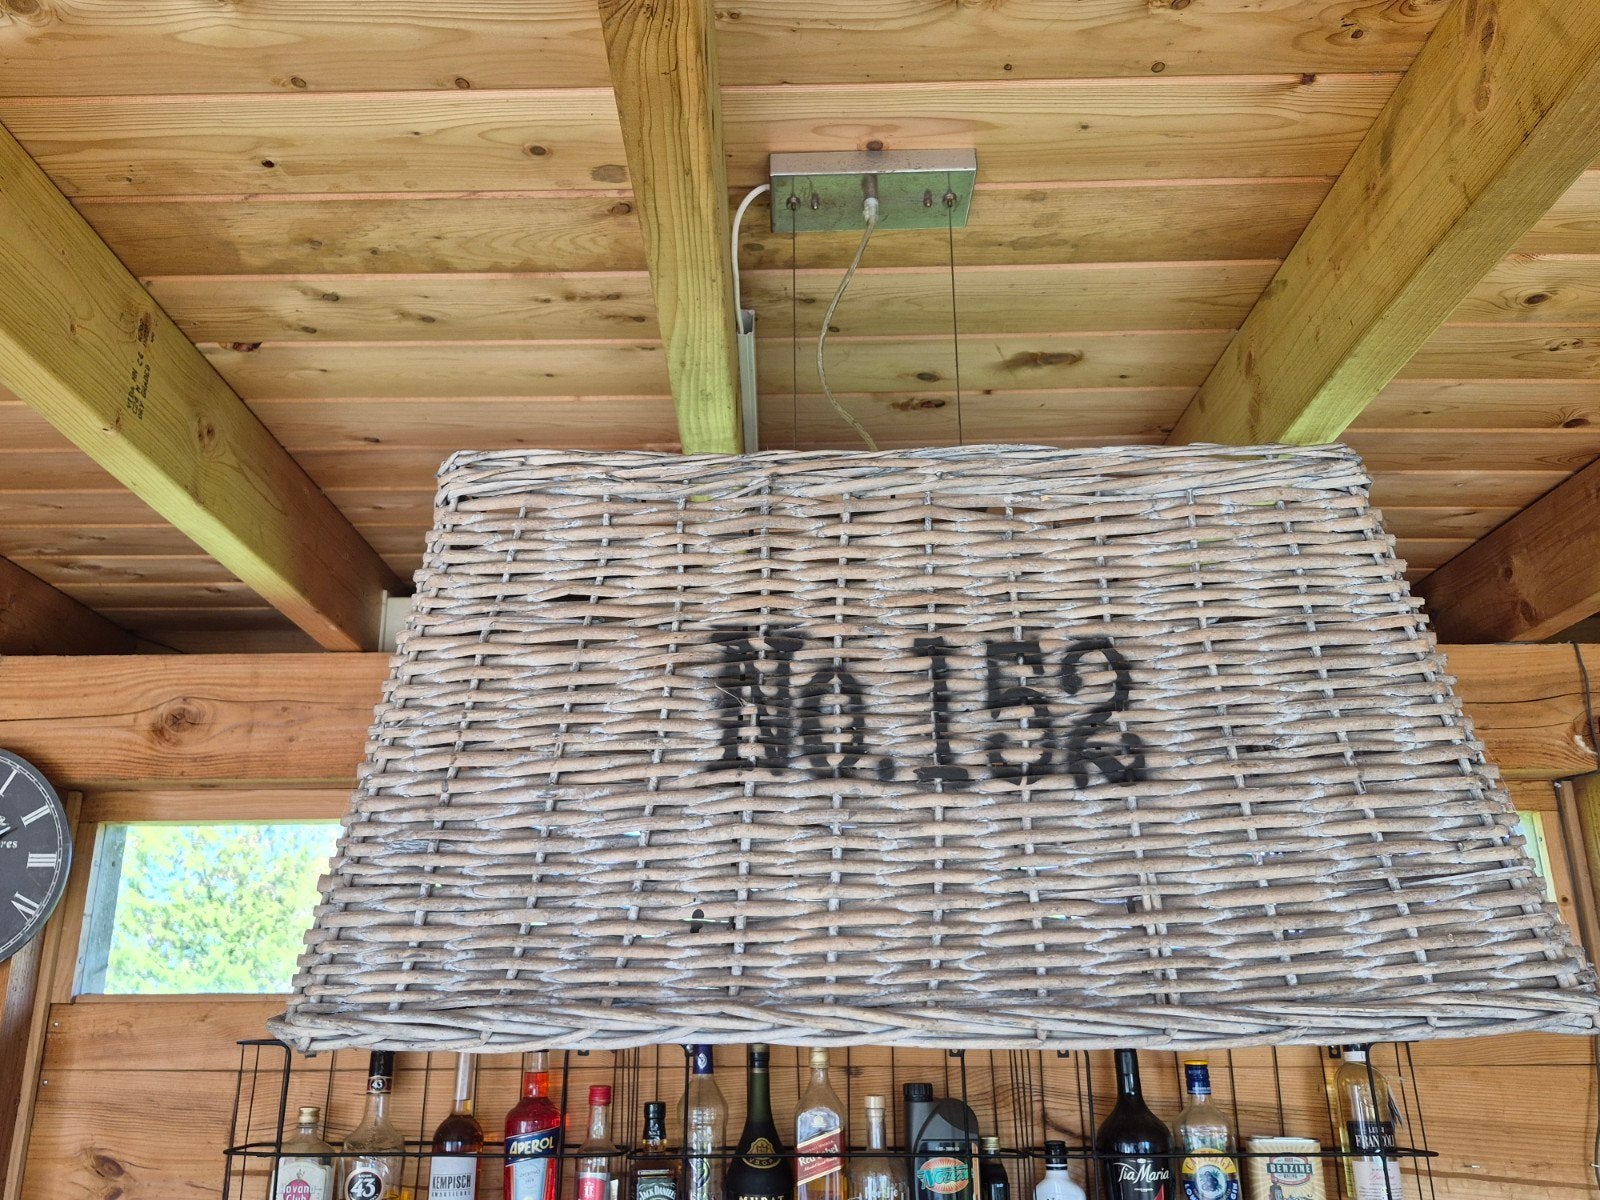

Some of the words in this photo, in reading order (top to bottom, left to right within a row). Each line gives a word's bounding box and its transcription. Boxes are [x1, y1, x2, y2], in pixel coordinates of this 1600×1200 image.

[509, 1135, 555, 1156] APEROL
[1355, 1134, 1395, 1149] FRANOLI
[1113, 1162, 1138, 1183] Tia
[1133, 1163, 1170, 1184] Maria
[1270, 1164, 1311, 1174] BENZINE
[350, 1177, 376, 1198] 43
[432, 1174, 472, 1190] KEMPISCH
[639, 1188, 656, 1200] JACK
